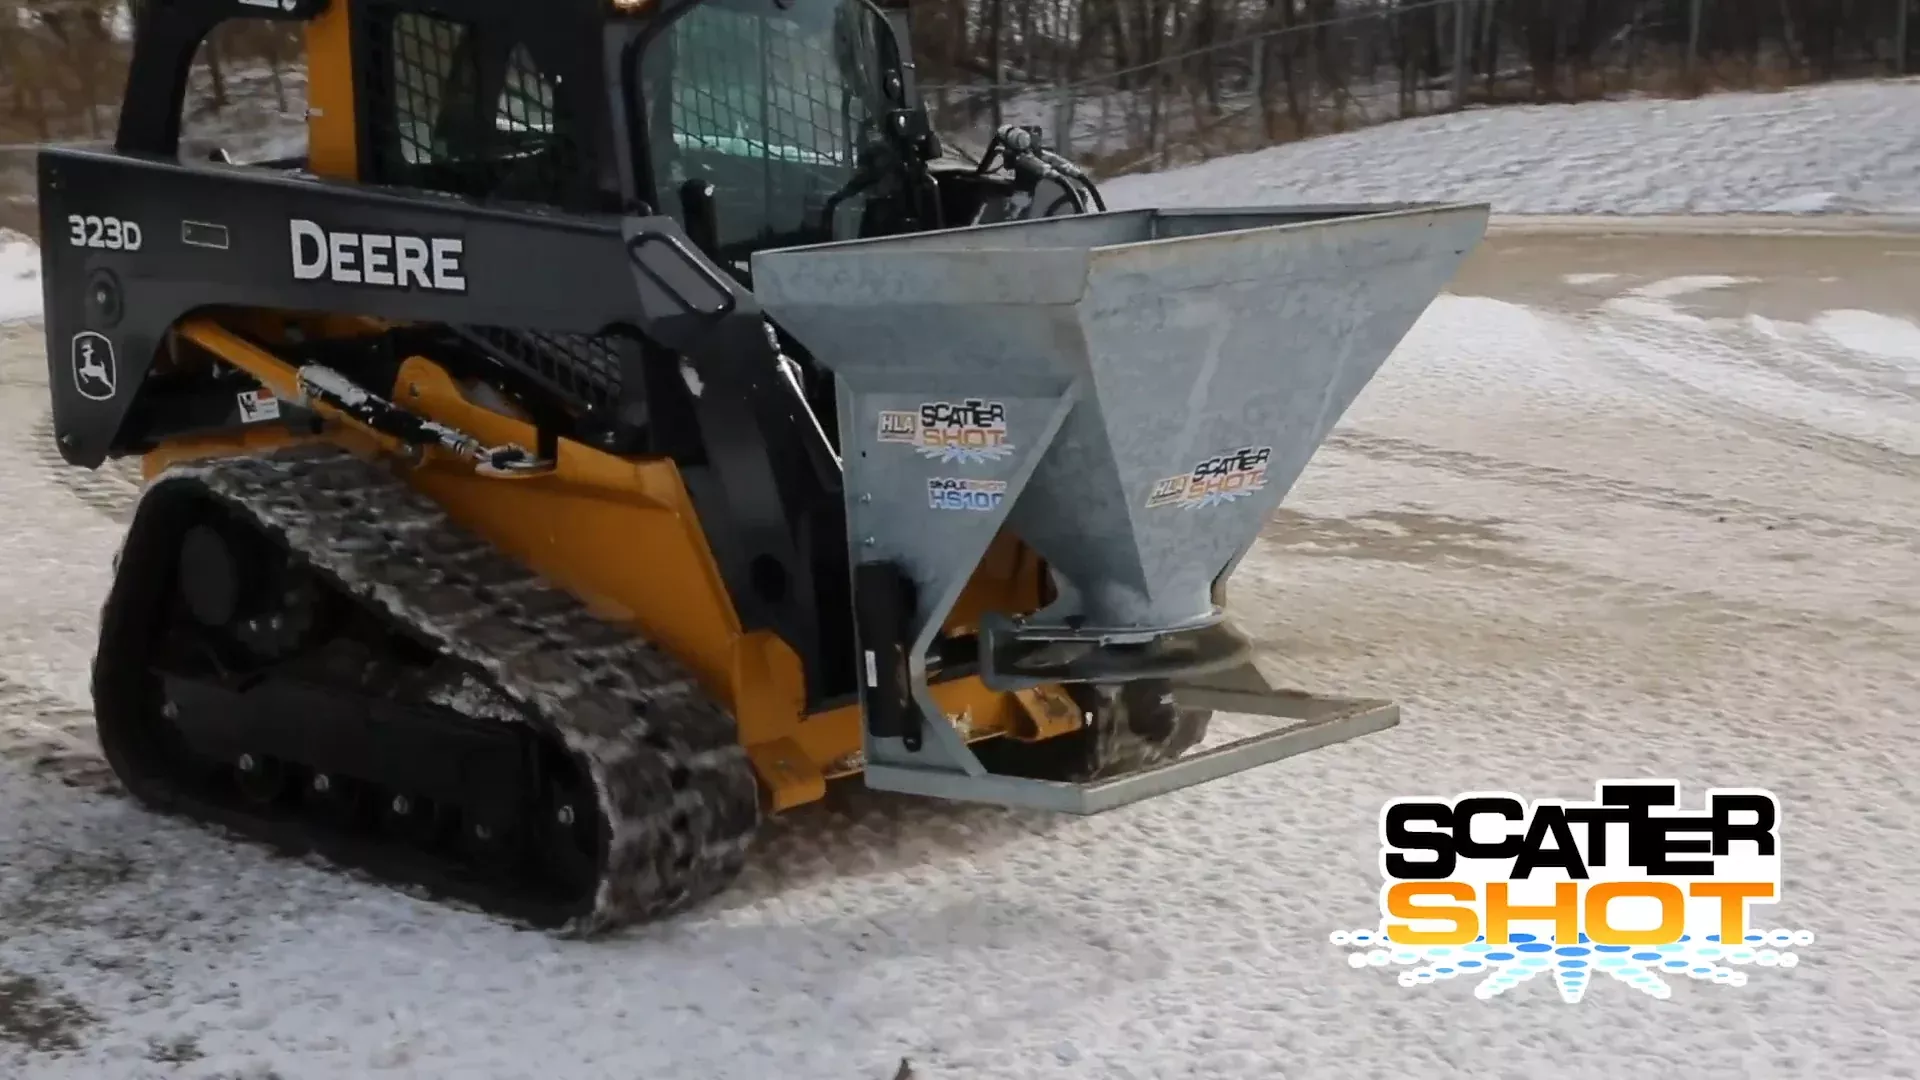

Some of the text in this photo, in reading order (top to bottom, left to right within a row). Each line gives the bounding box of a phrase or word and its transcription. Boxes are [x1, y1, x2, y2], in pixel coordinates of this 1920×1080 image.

[68, 215, 142, 250] 323D
[290, 219, 465, 290] DEERE
[882, 414, 915, 433] HLA
[922, 400, 1004, 428] SCATTER
[923, 429, 1005, 447] SHOT
[1189, 471, 1263, 498] SHOT
